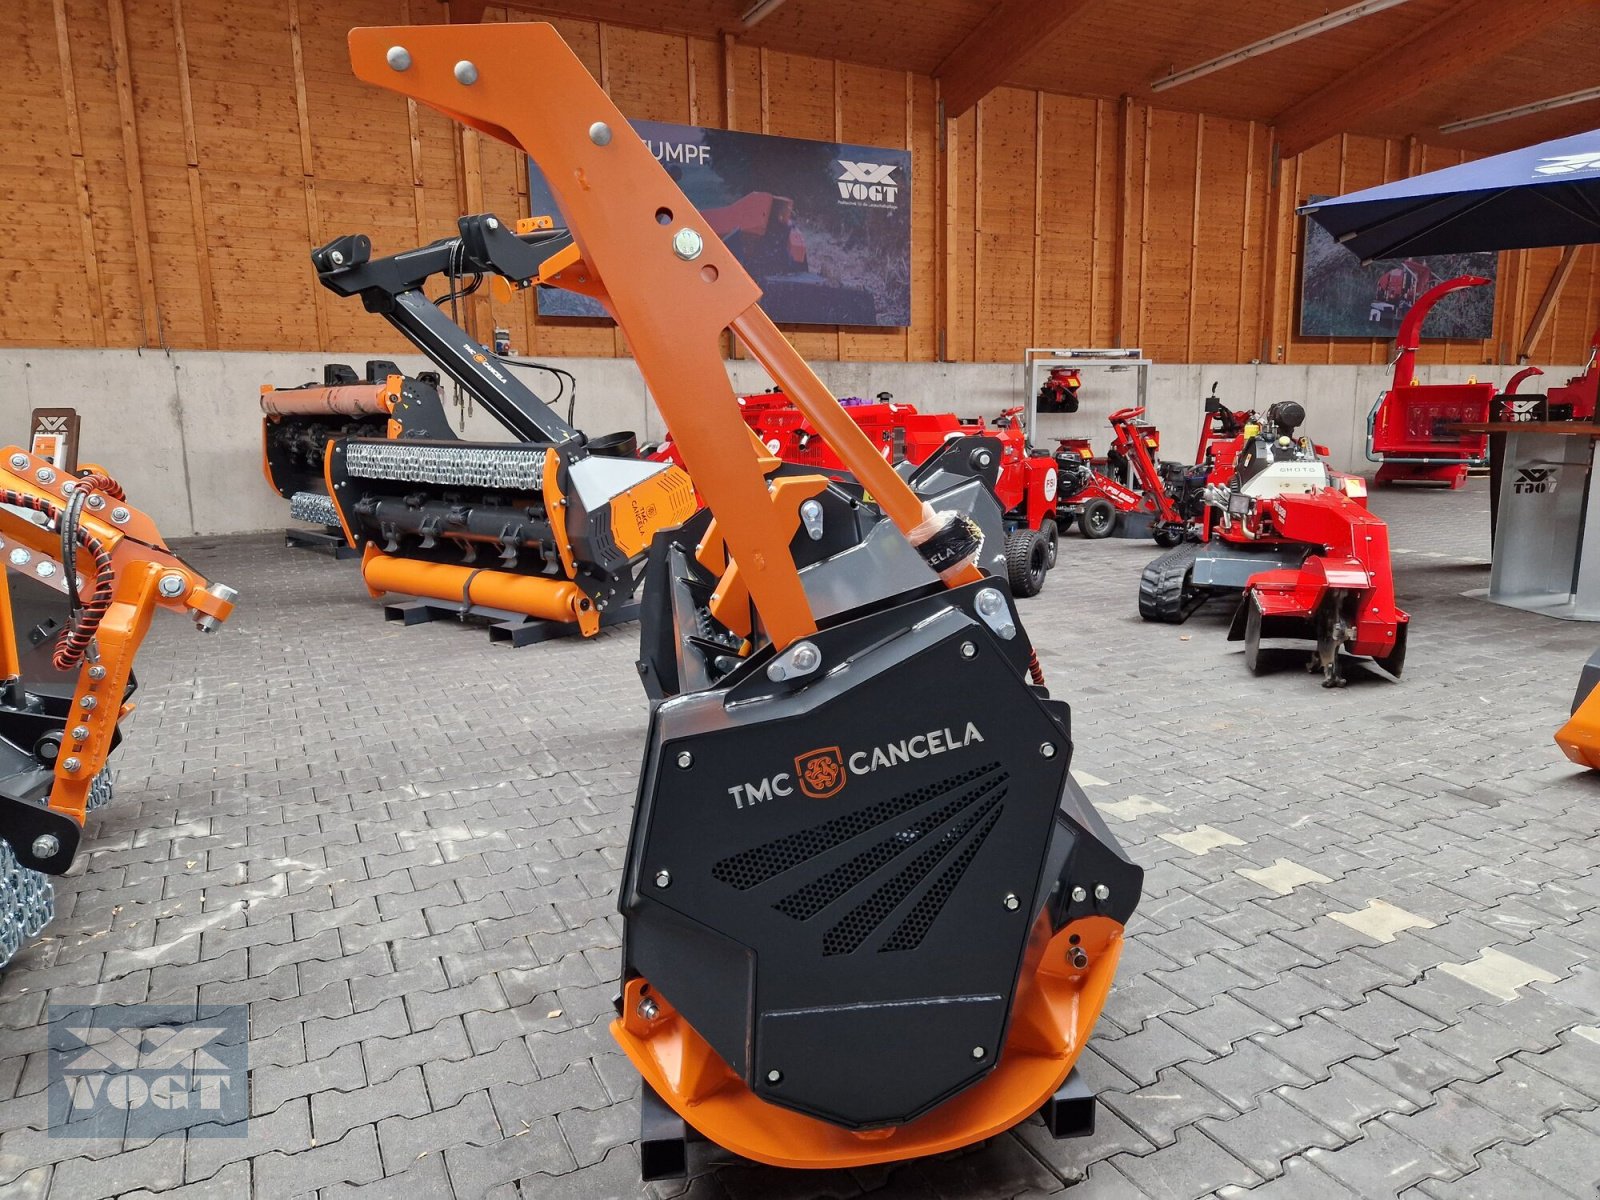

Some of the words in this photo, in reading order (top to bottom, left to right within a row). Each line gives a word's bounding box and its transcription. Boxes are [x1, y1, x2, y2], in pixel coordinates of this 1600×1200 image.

[642, 140, 711, 165] UMPF
[837, 182, 898, 203] VOGT
[728, 773, 794, 809] TMC
[849, 721, 985, 775] CANCELA
